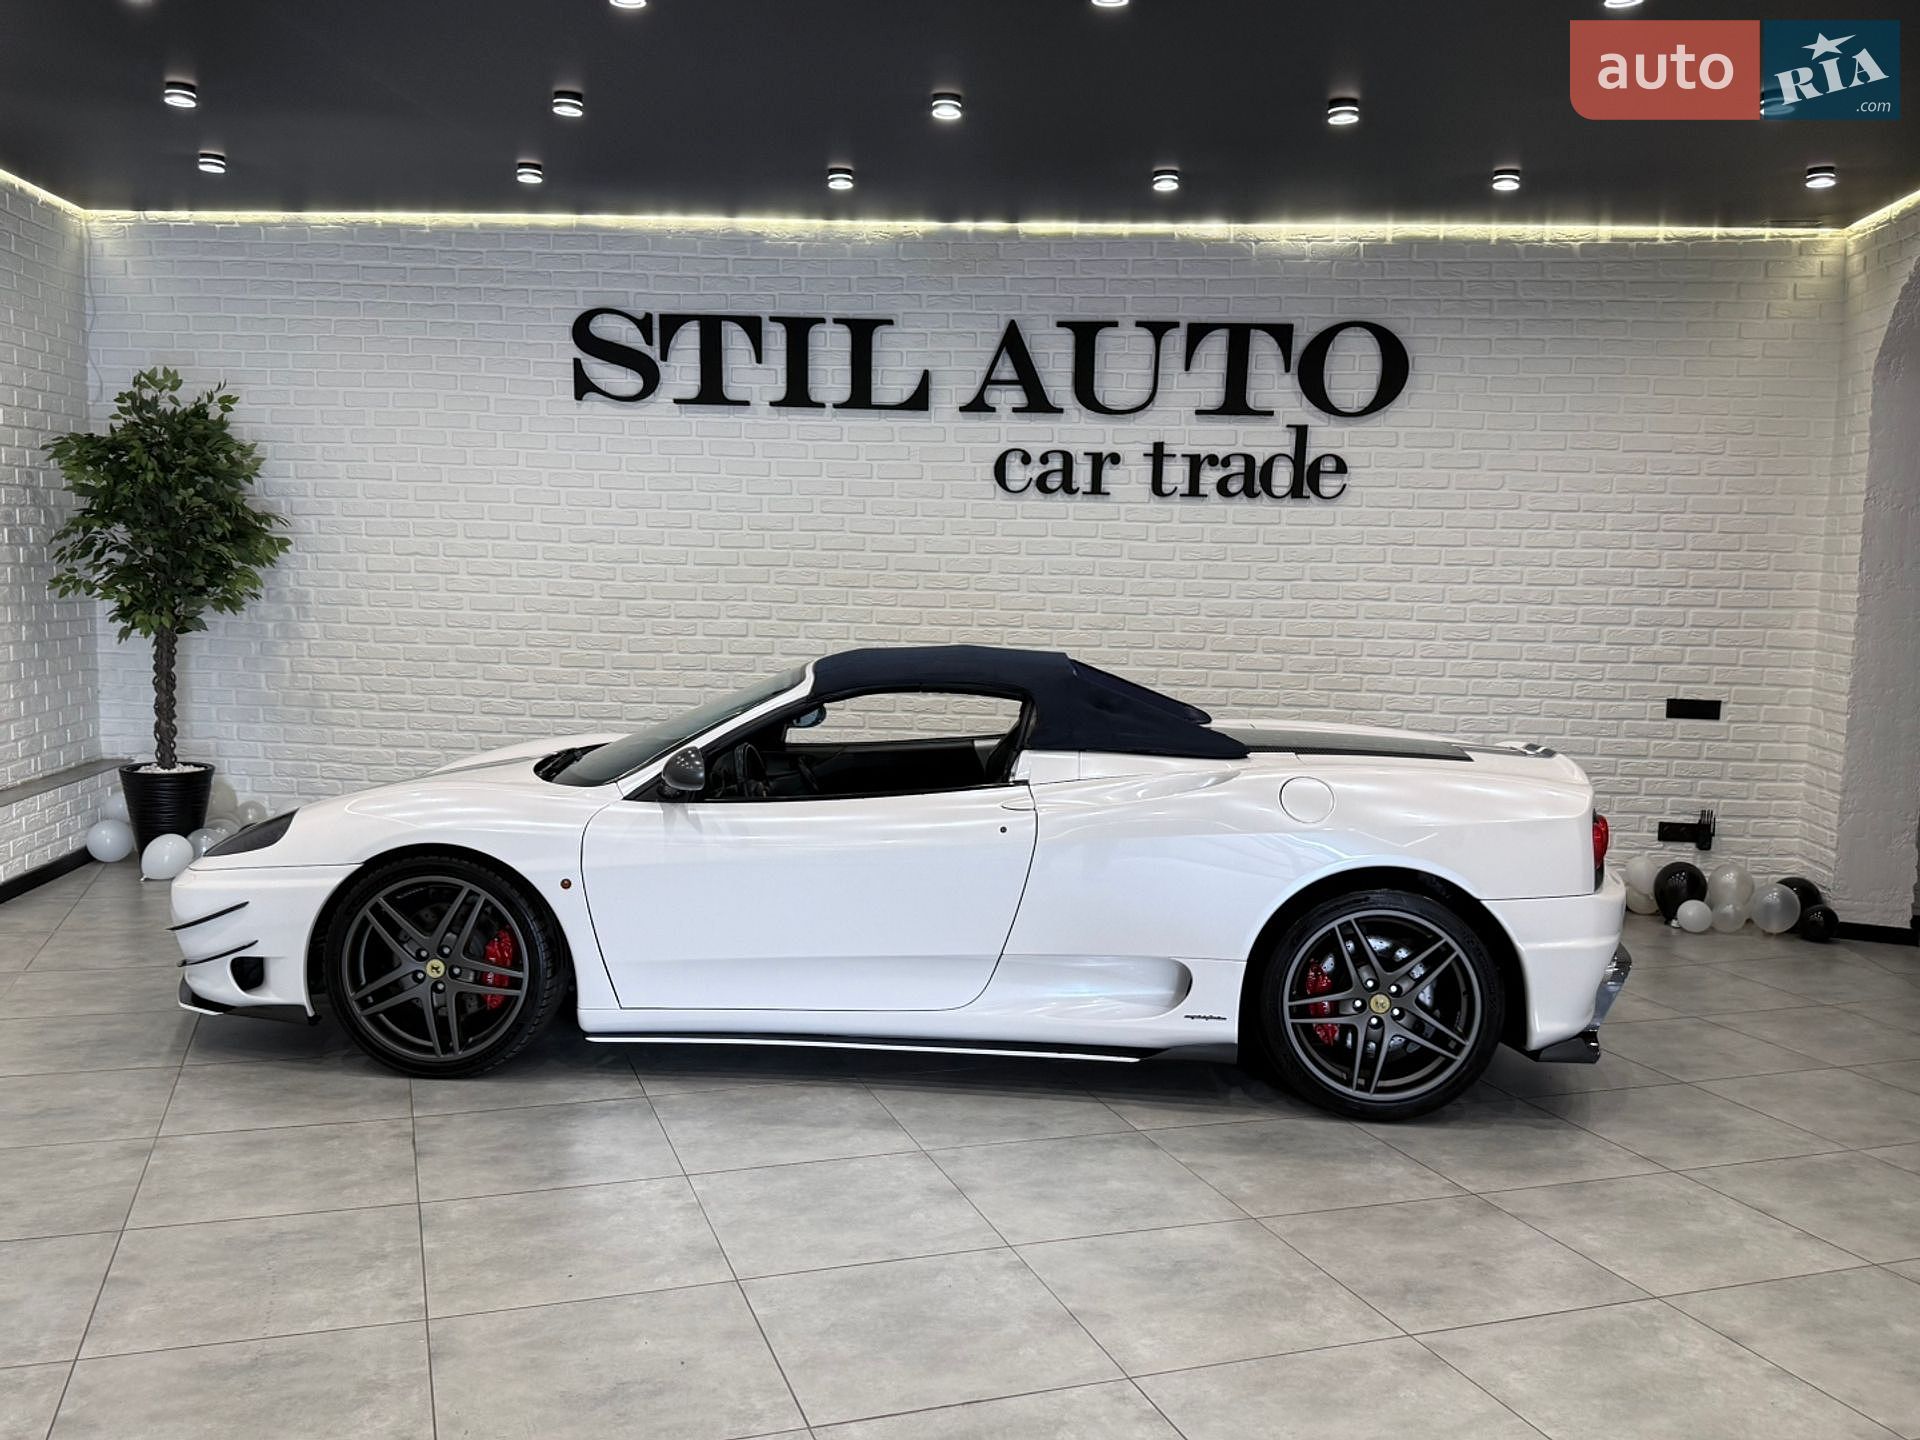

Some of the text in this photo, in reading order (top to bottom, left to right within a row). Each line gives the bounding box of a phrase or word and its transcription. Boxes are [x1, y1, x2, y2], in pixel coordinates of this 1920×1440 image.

[571, 307, 1410, 417] STIL AUTO
[993, 423, 1348, 500] car trade
